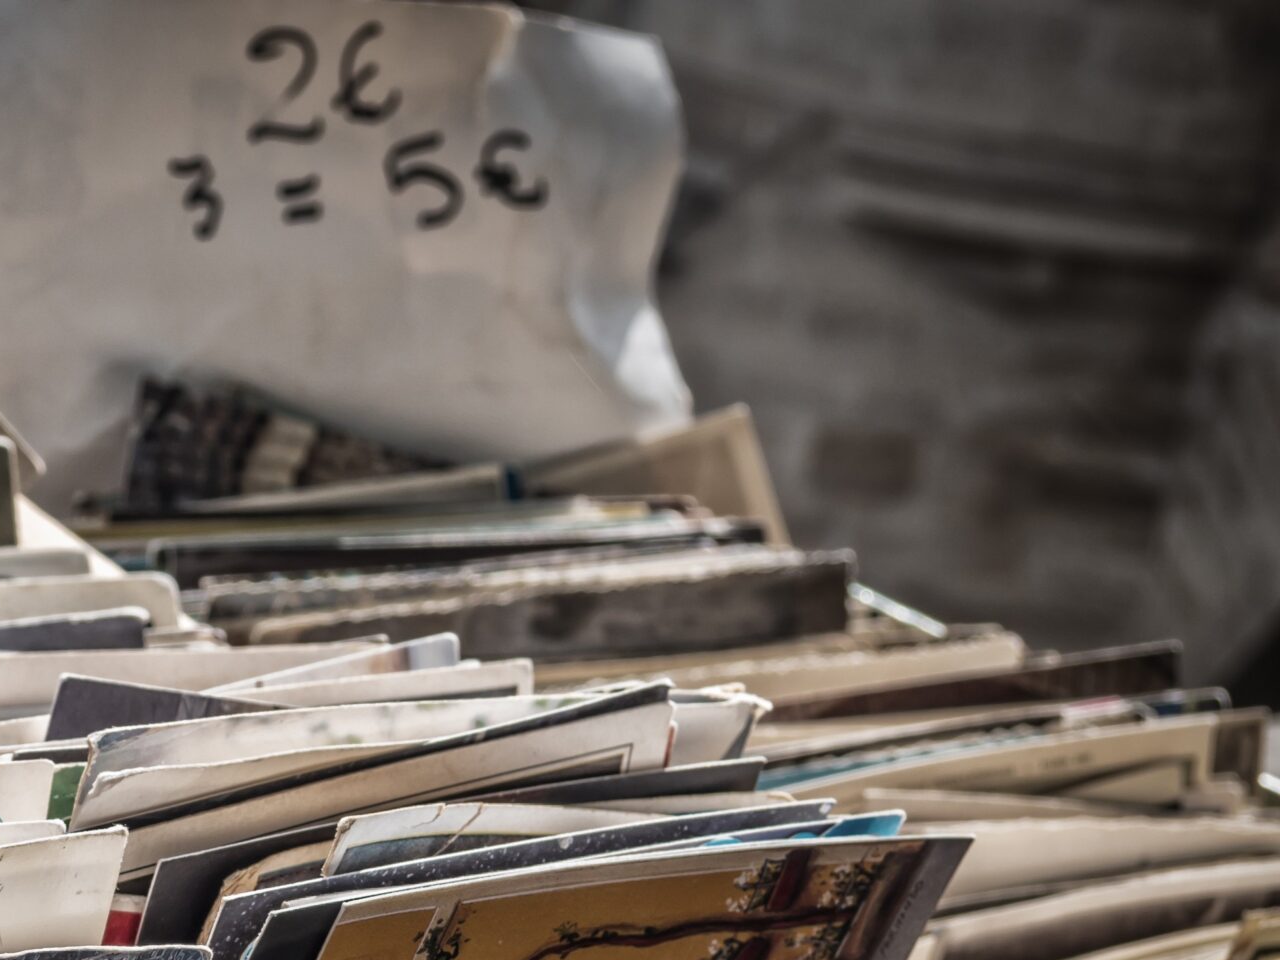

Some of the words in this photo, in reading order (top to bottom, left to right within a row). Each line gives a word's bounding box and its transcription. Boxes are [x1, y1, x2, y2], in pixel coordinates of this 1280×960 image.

[246, 20, 403, 145] 2€
[168, 155, 224, 241] 3
[276, 174, 324, 225] =
[382, 130, 550, 231] 5€
